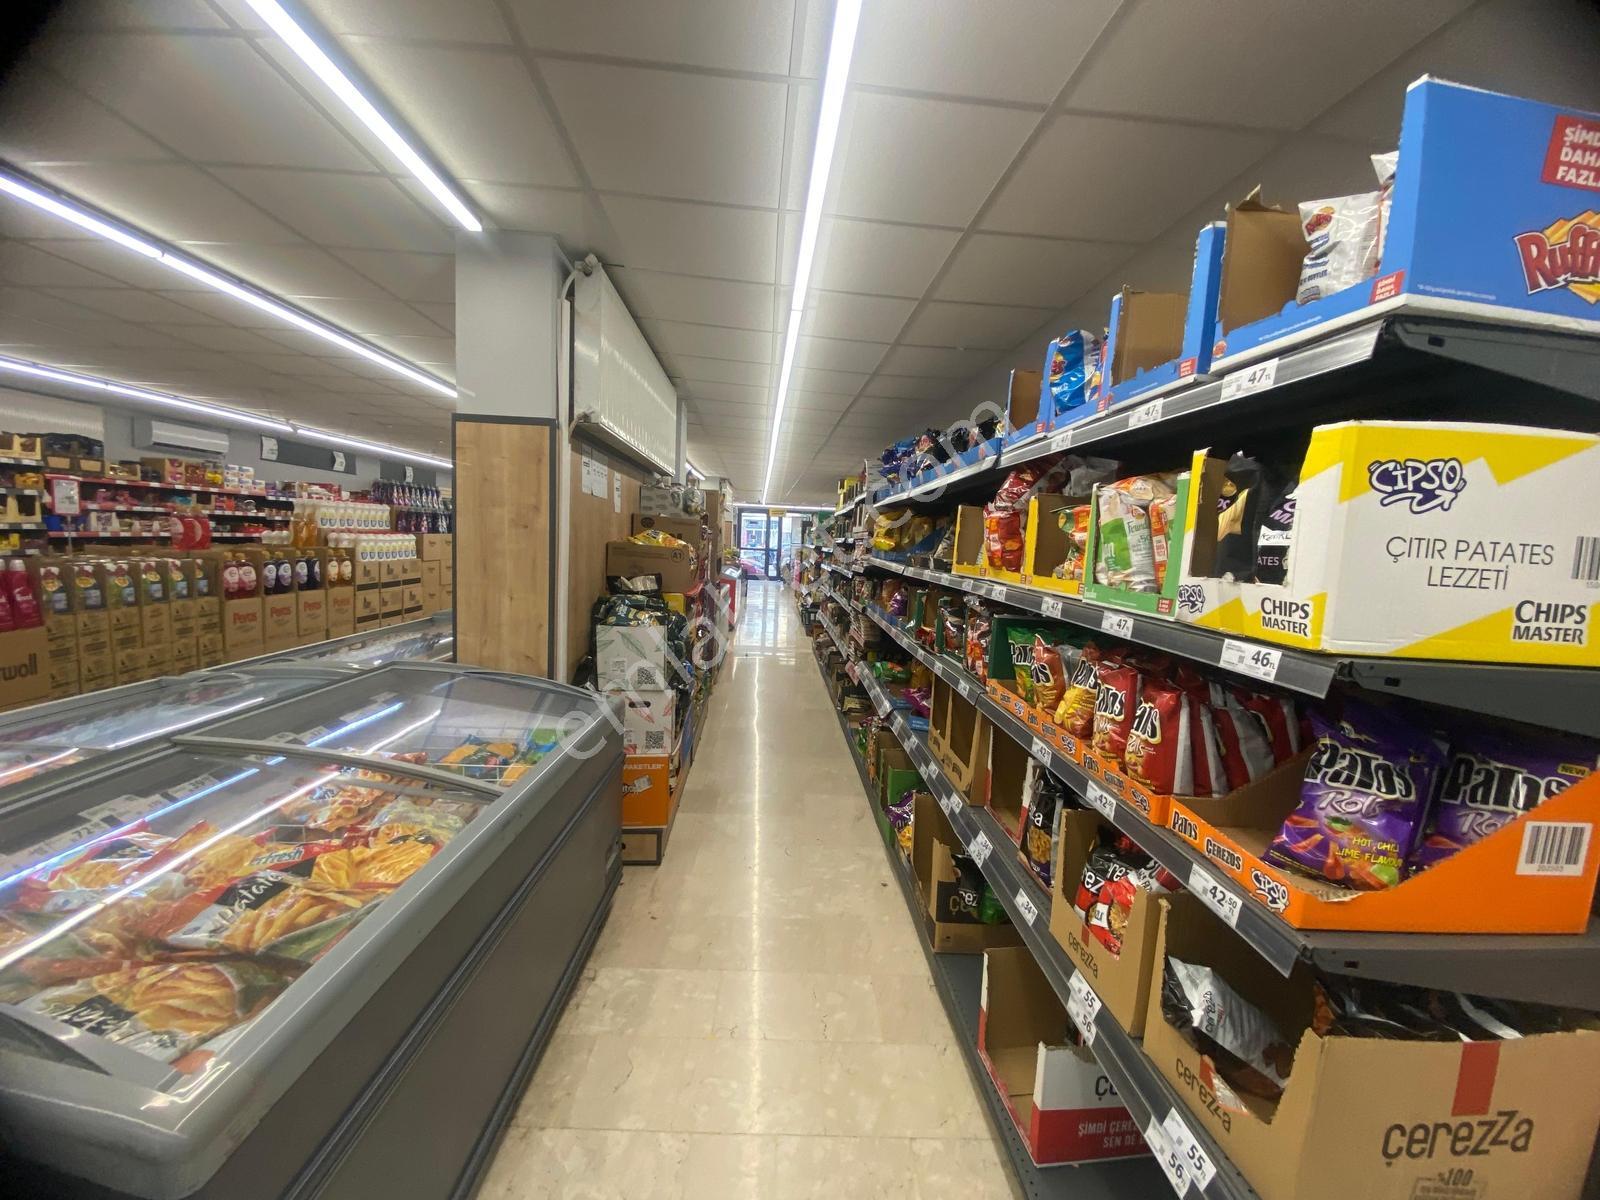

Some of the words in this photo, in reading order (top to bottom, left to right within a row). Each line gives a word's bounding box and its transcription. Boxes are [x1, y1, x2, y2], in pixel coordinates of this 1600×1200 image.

[1556, 166, 1600, 187] FAZL
[1247, 367, 1266, 385] 47
[1386, 536, 1448, 563] ÇITIR
[1454, 539, 1554, 566] PATATES
[1427, 565, 1509, 591] LEZZETİ
[1260, 597, 1310, 619] CHIPS
[1515, 600, 1587, 624] CHIPS
[1117, 619, 1128, 630] 47
[1261, 616, 1308, 637] MASTER
[1512, 625, 1584, 645] MASTER
[1251, 650, 1270, 668] 46
[1560, 765, 1586, 777] NEW
[1083, 990, 1096, 1008] 55
[1082, 1014, 1092, 1033] 56
[1168, 1152, 1184, 1179] 56
[1187, 1145, 1206, 1171] 55
